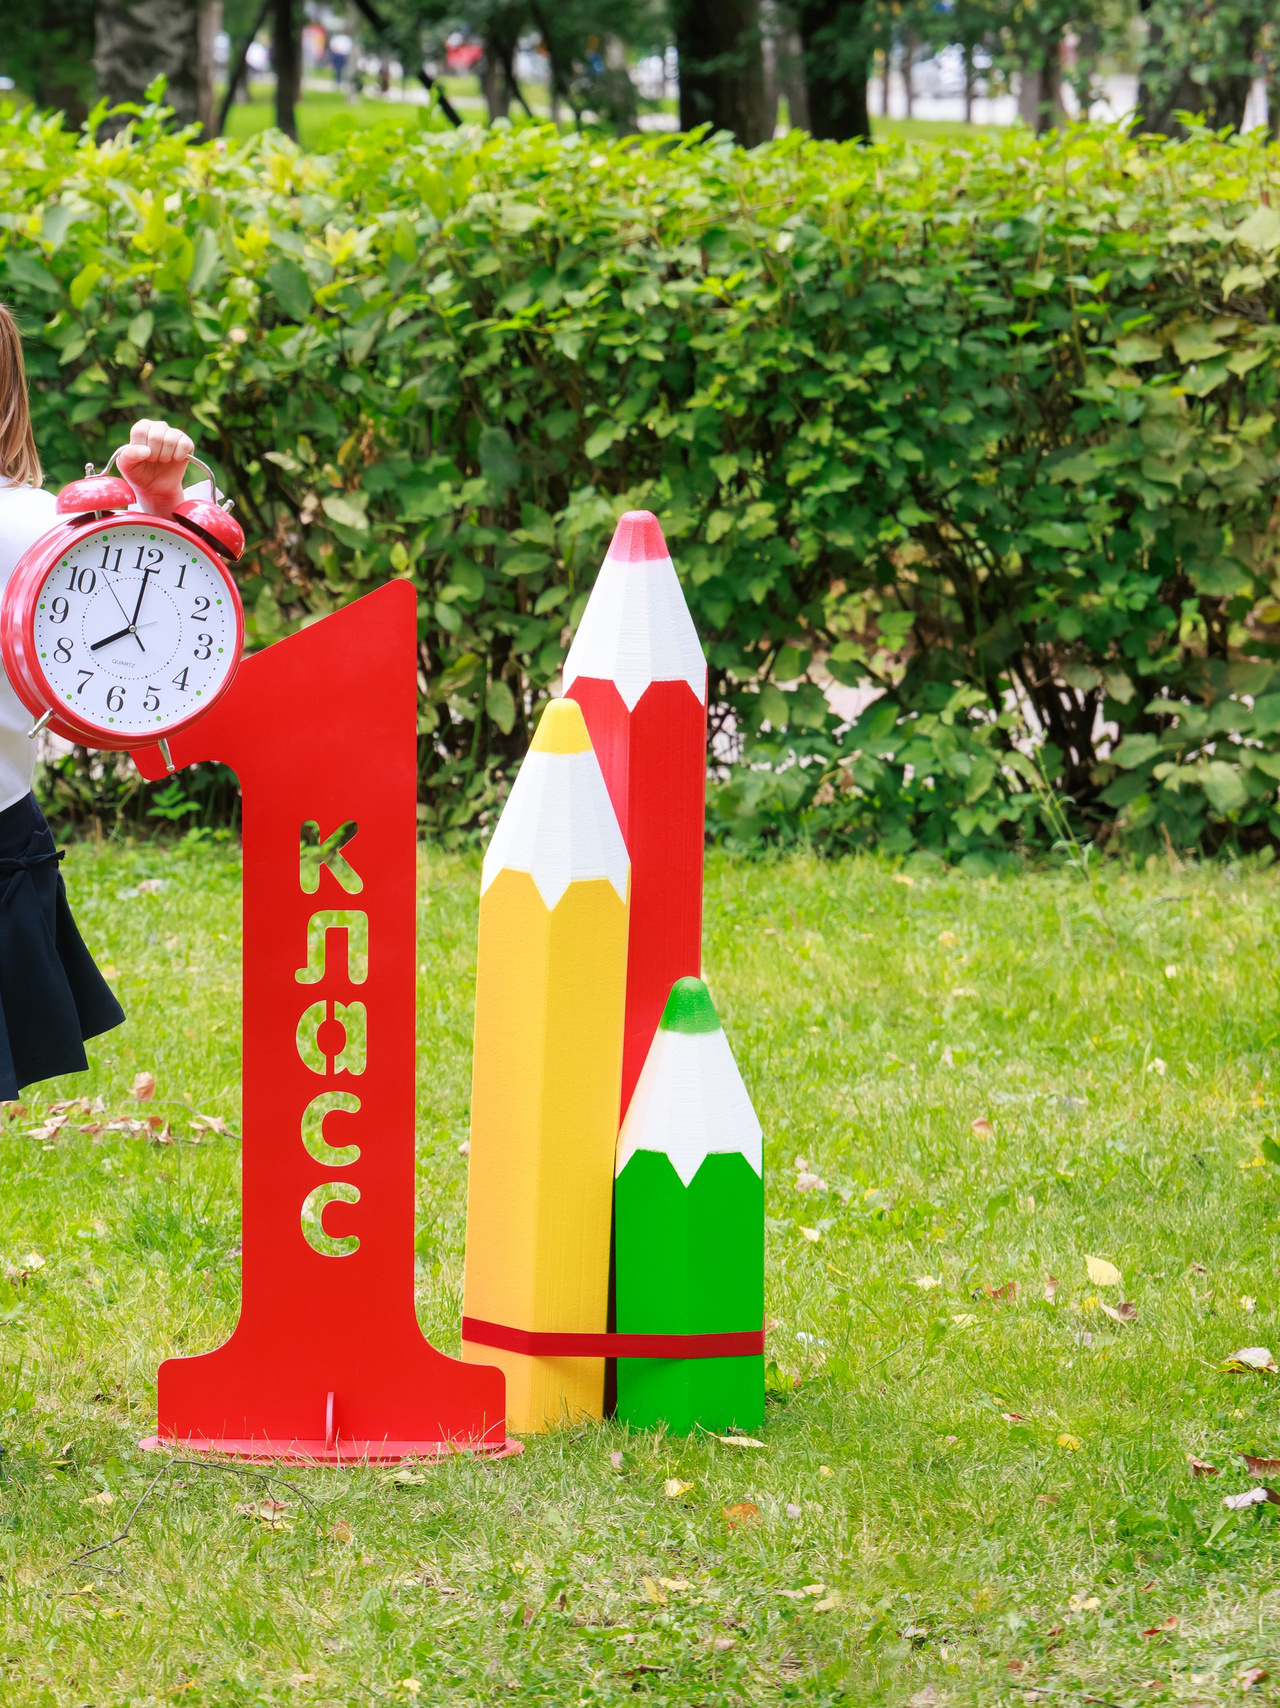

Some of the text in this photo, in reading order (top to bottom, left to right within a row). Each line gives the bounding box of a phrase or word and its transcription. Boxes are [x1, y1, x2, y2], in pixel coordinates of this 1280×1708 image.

[97, 545, 123, 573] 11
[132, 545, 164, 575] 12
[65, 565, 96, 595] 10
[174, 564, 187, 589] 1
[49, 596, 69, 624] 9
[190, 595, 211, 622] 2
[53, 637, 74, 664] 8
[193, 633, 213, 660] 3
[111, 658, 136, 669] QUARTZ
[77, 669, 94, 695] 7
[171, 666, 190, 692] 4
[106, 685, 126, 712] 6
[143, 685, 162, 712] 5
